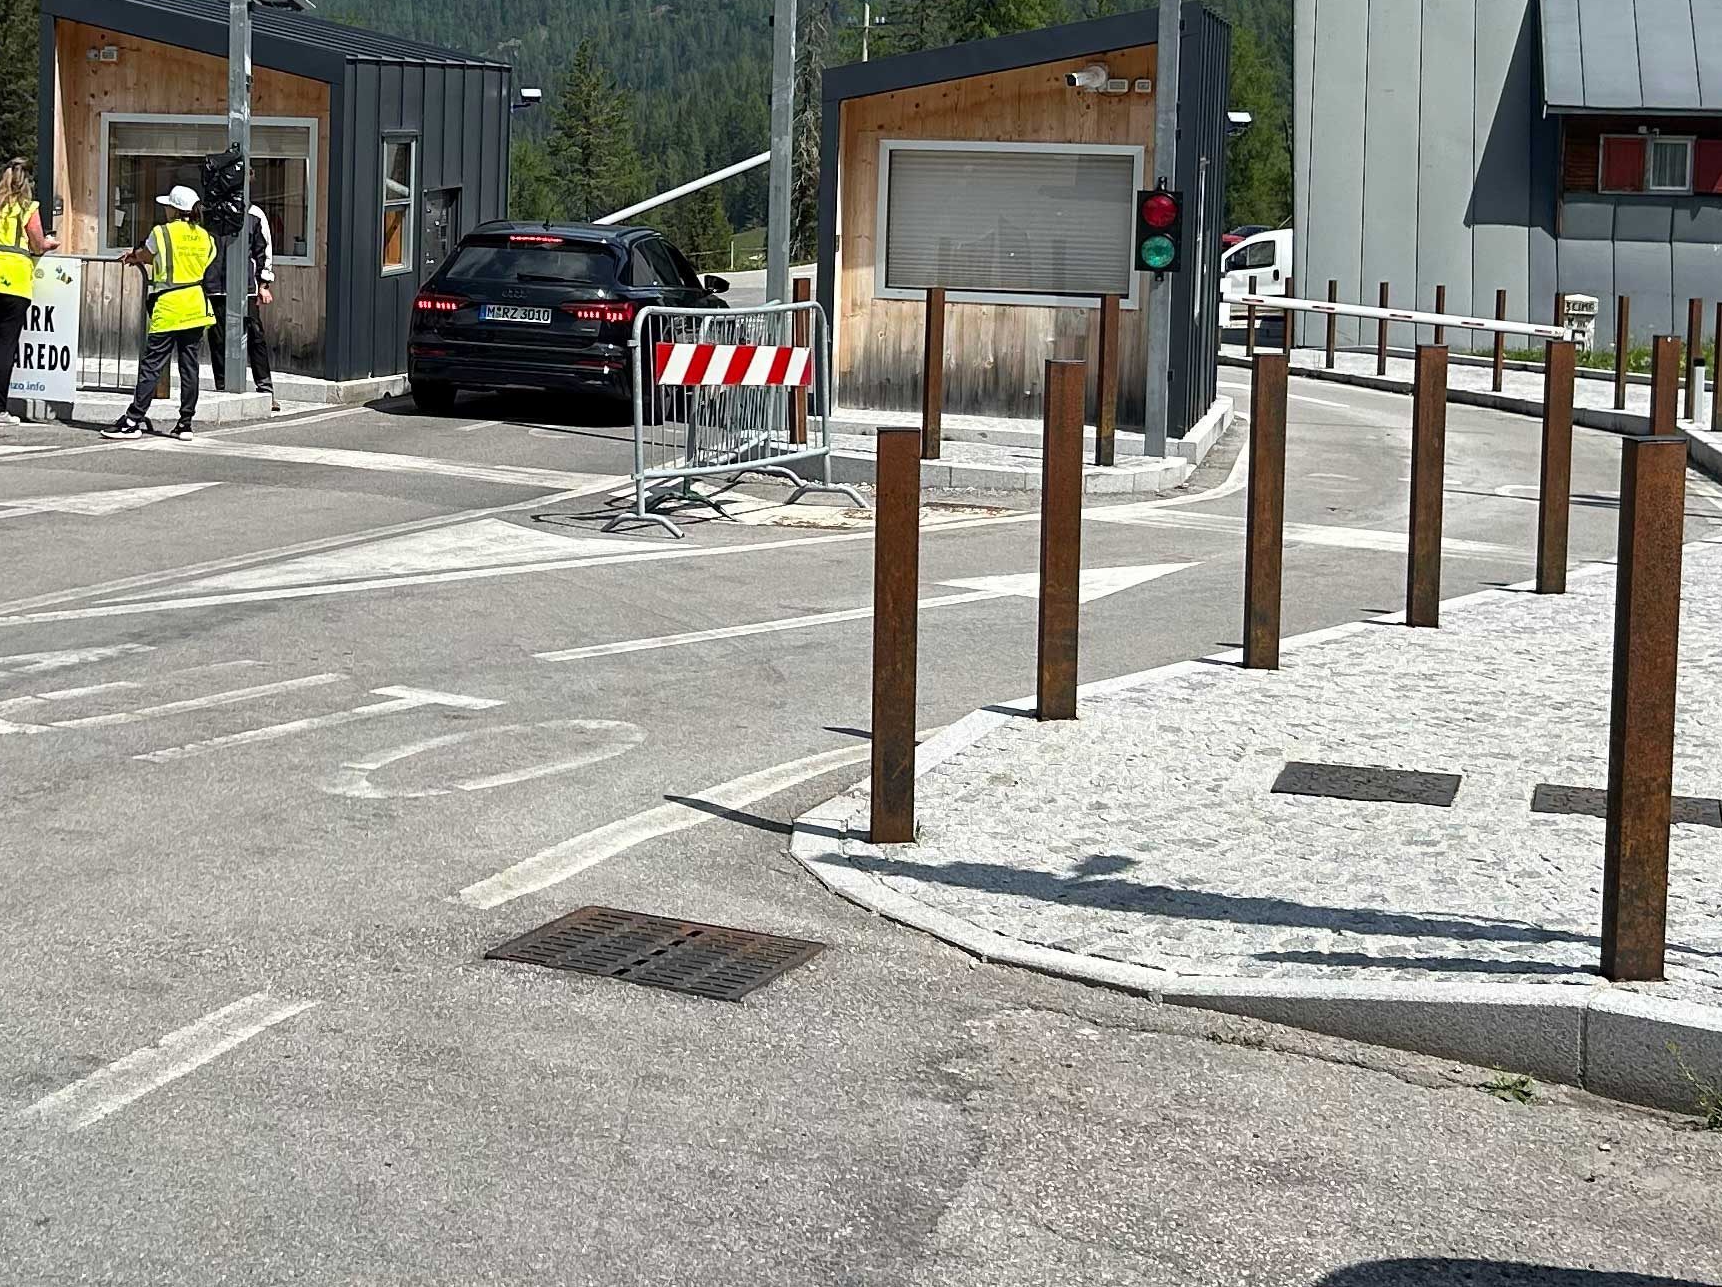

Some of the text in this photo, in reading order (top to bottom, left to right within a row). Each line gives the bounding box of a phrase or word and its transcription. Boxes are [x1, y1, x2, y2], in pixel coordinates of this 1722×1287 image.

[24, 305, 55, 332] RK
[487, 306, 549, 321] M RZ 3010
